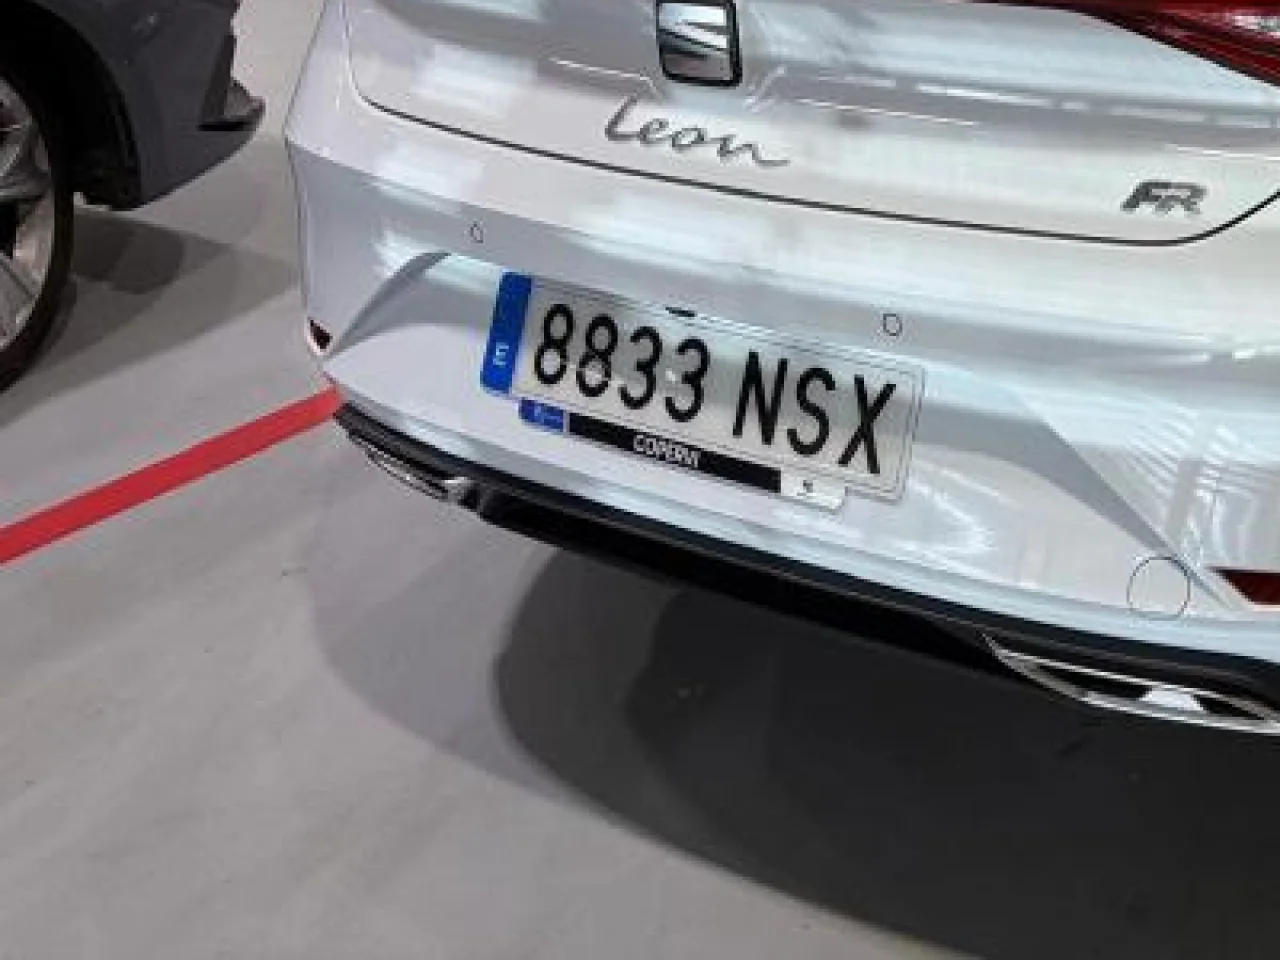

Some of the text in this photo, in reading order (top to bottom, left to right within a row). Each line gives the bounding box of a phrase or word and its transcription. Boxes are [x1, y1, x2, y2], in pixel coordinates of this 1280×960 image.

[605, 94, 790, 169] Leon
[1121, 180, 1206, 214] FR
[492, 342, 510, 367] E
[534, 304, 897, 474] 8833 NSX
